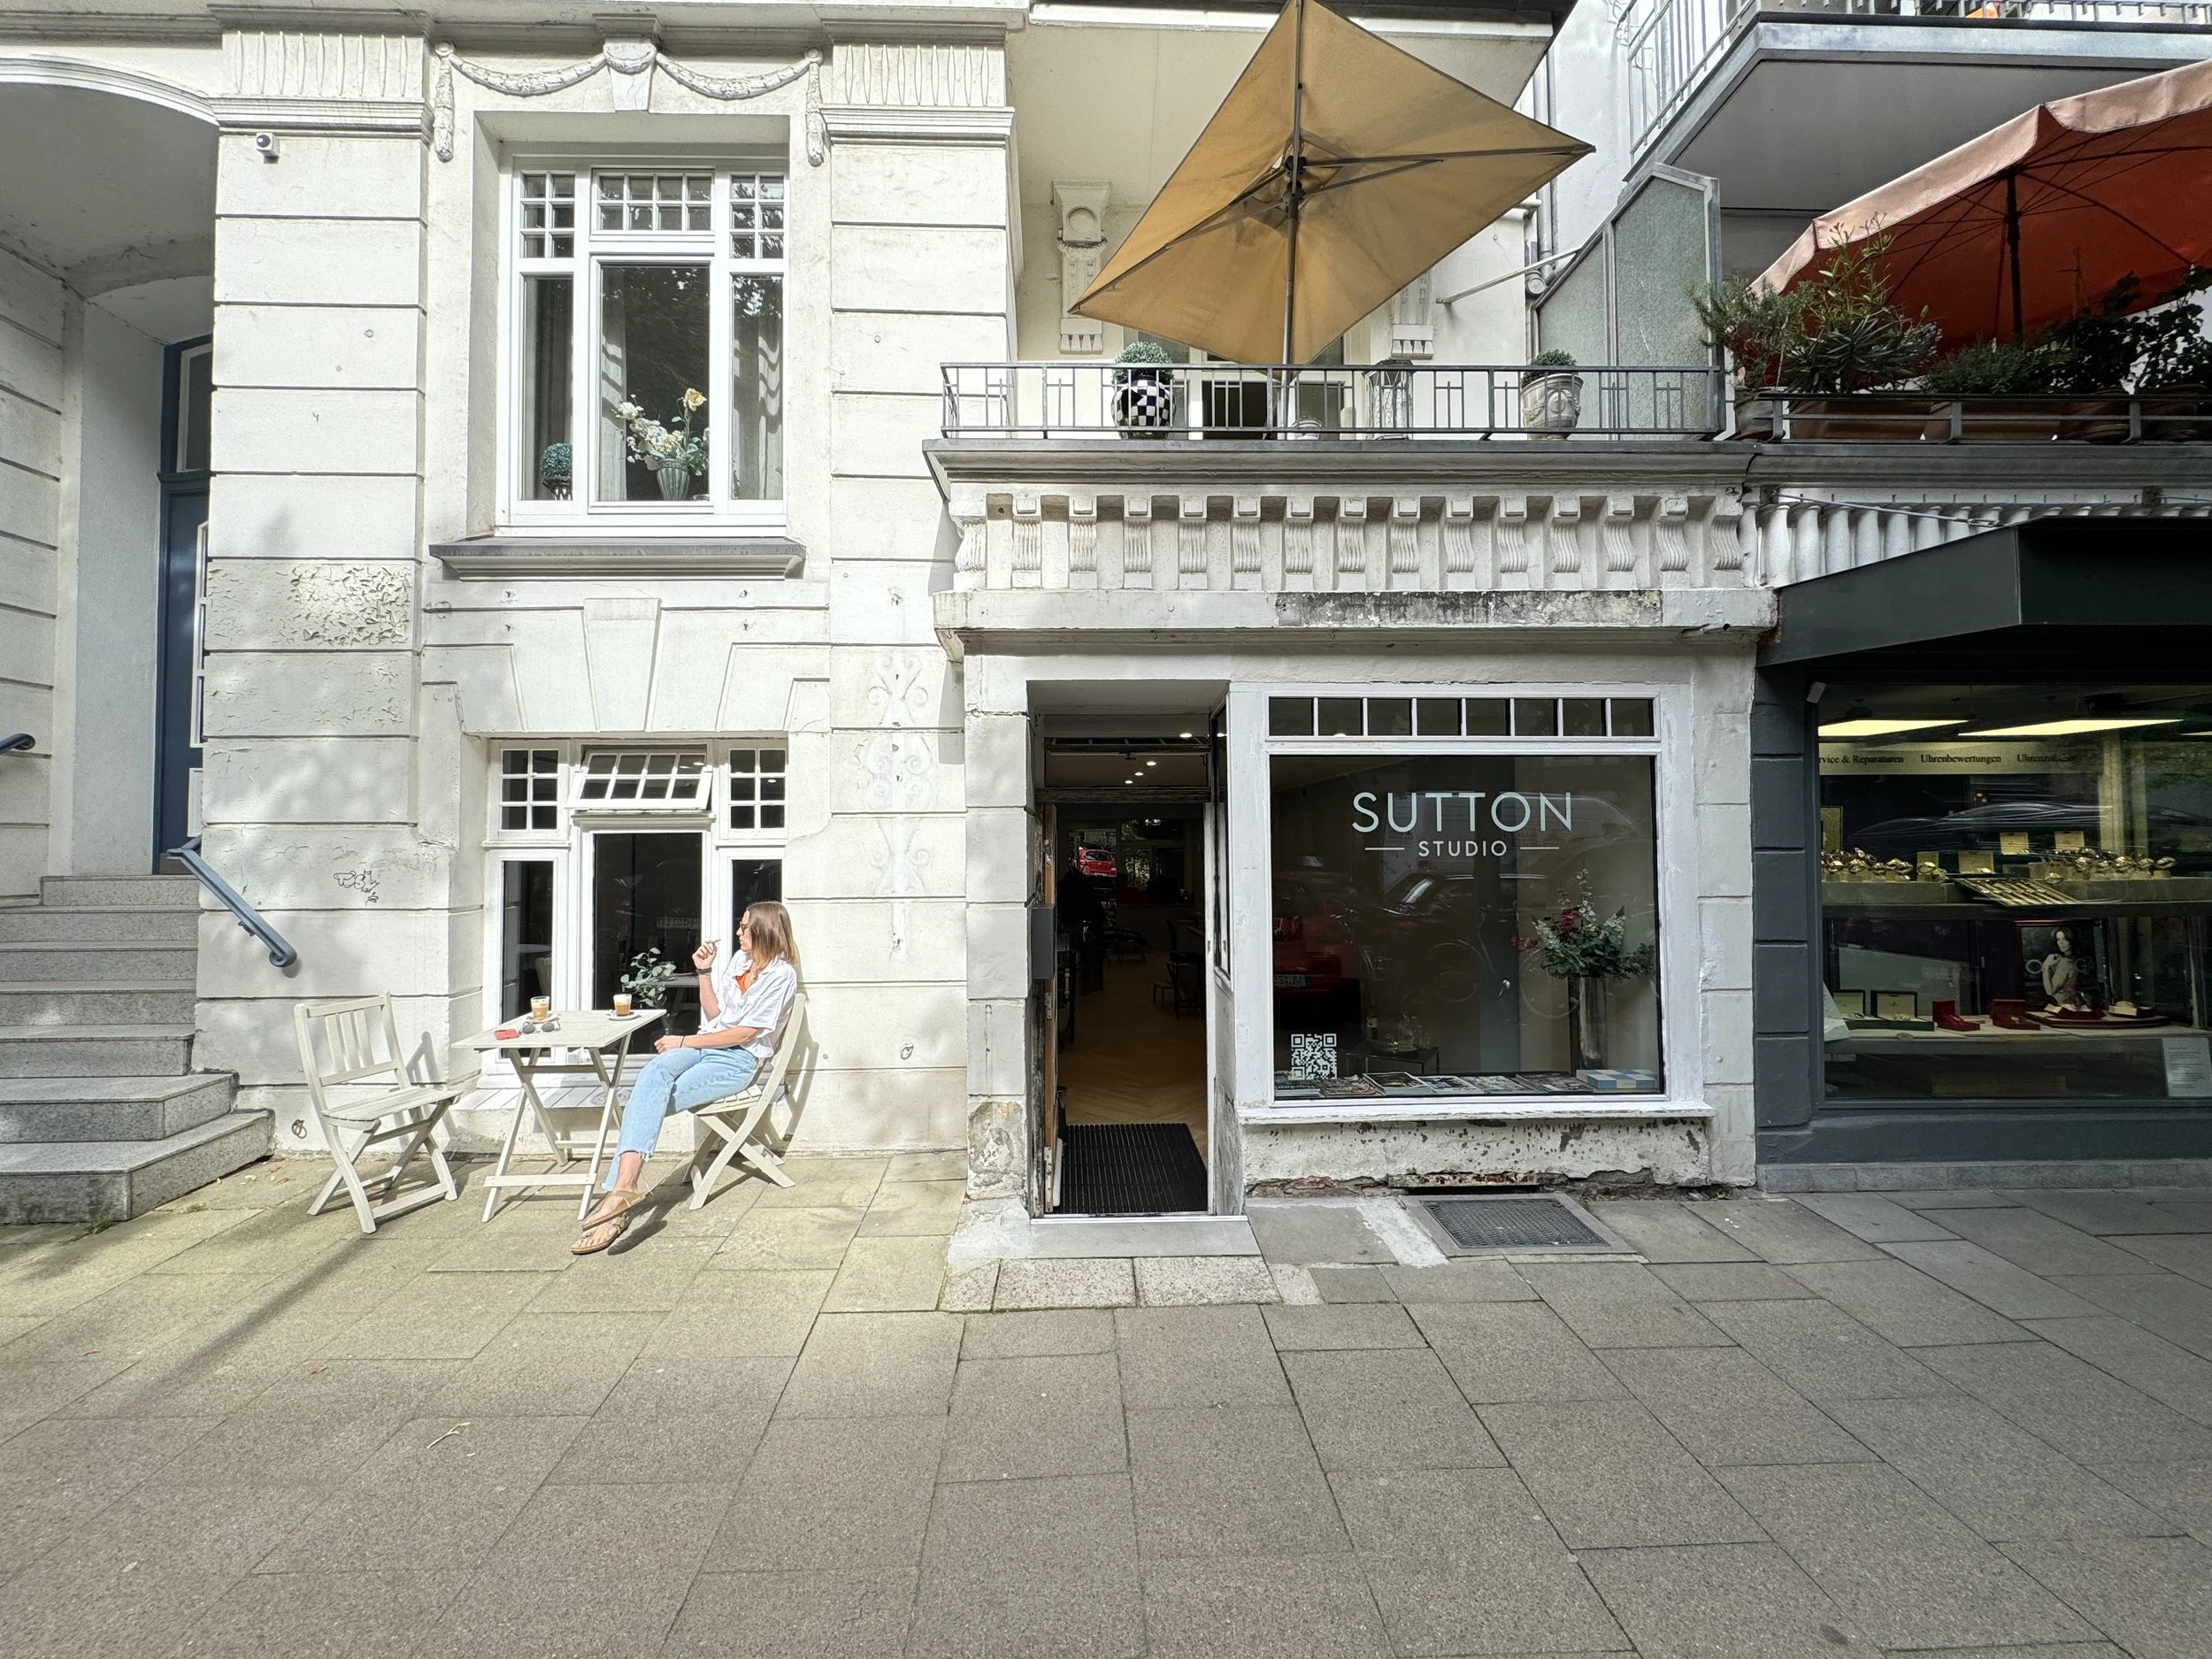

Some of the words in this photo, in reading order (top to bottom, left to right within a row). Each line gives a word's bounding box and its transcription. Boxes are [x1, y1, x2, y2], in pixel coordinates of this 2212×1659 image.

[1818, 755, 1839, 764] rvice
[1841, 755, 1850, 764] &
[1854, 755, 1904, 765] Reparaturen
[1920, 754, 2001, 764] Uhrenbewertungen
[1352, 792, 1571, 833] SUTTON
[1418, 841, 1507, 857] STUDIO
